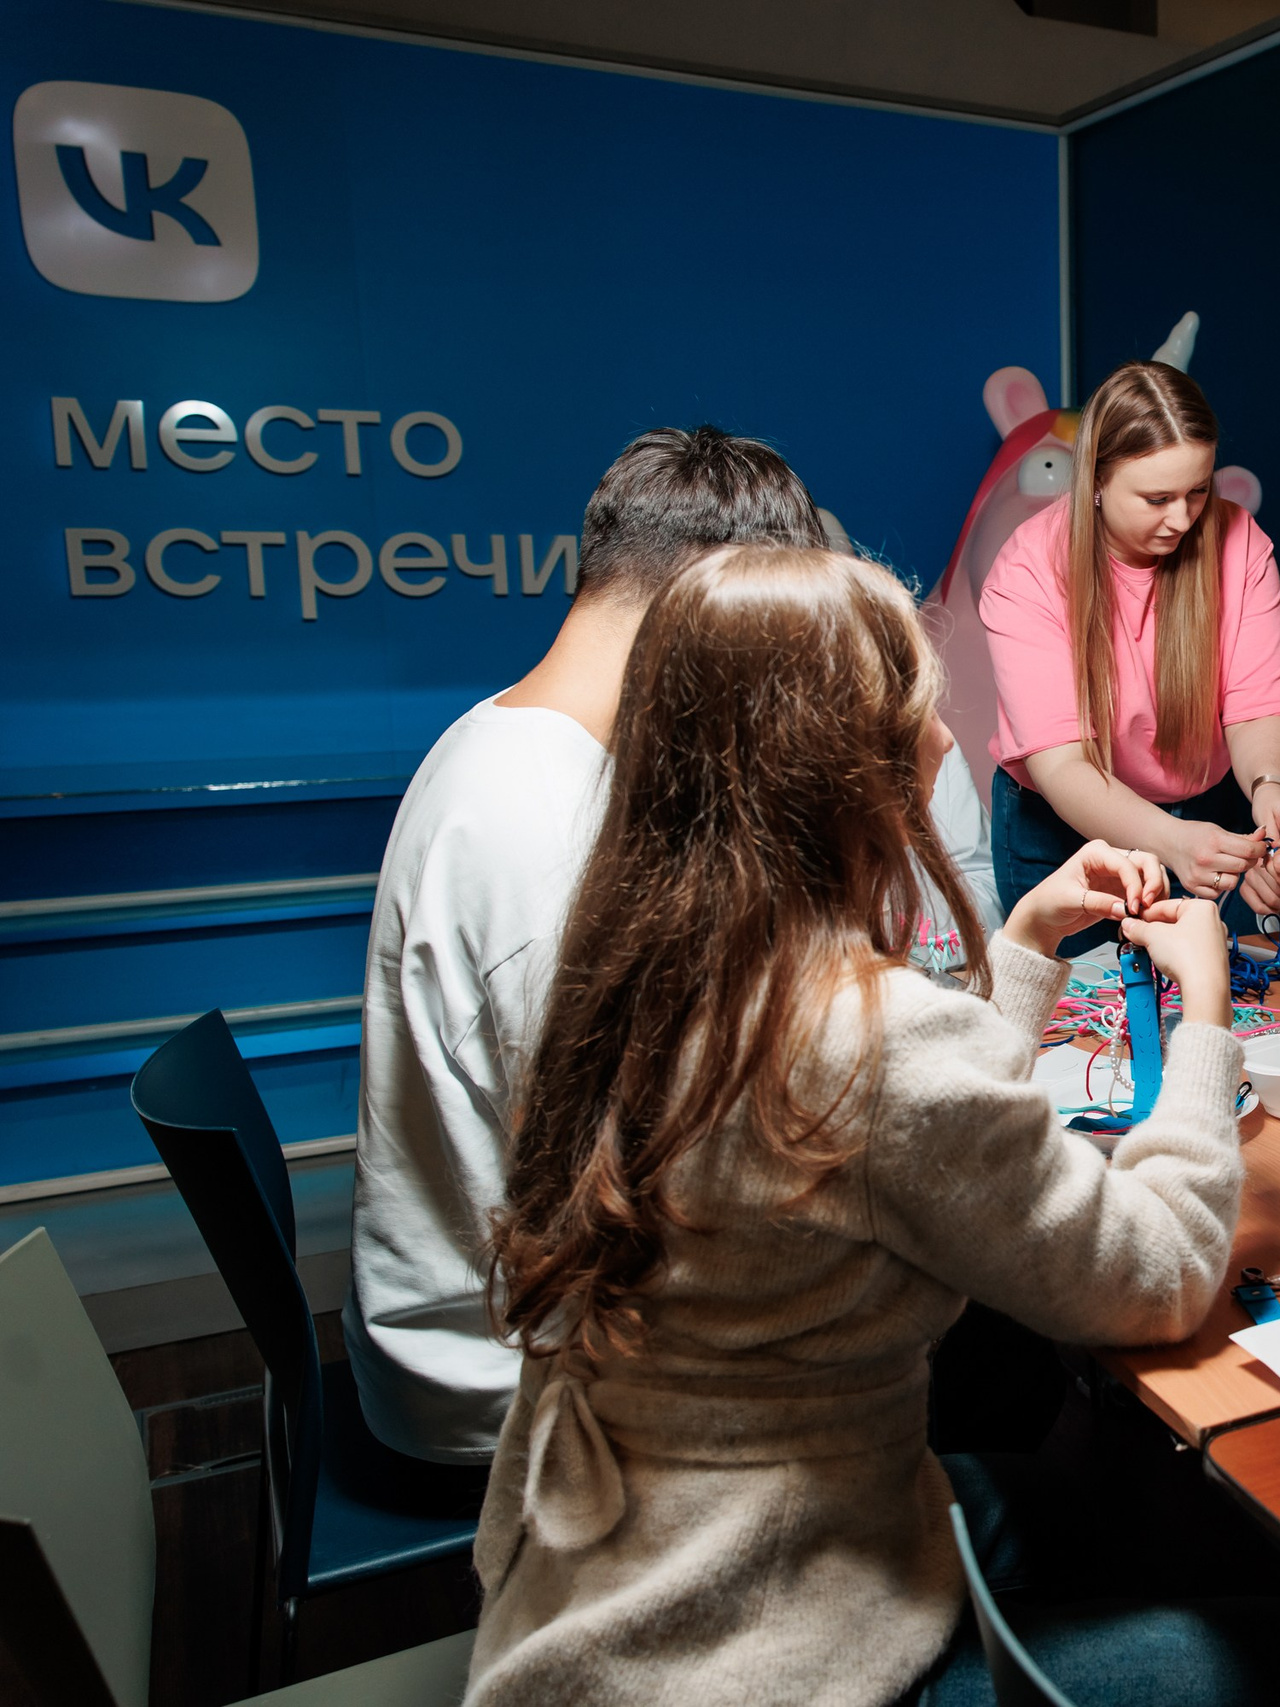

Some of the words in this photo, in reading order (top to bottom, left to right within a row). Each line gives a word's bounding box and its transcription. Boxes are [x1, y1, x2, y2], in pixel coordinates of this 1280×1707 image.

[55, 144, 222, 247] VK
[51, 396, 464, 479] место
[65, 527, 580, 620] встречи
